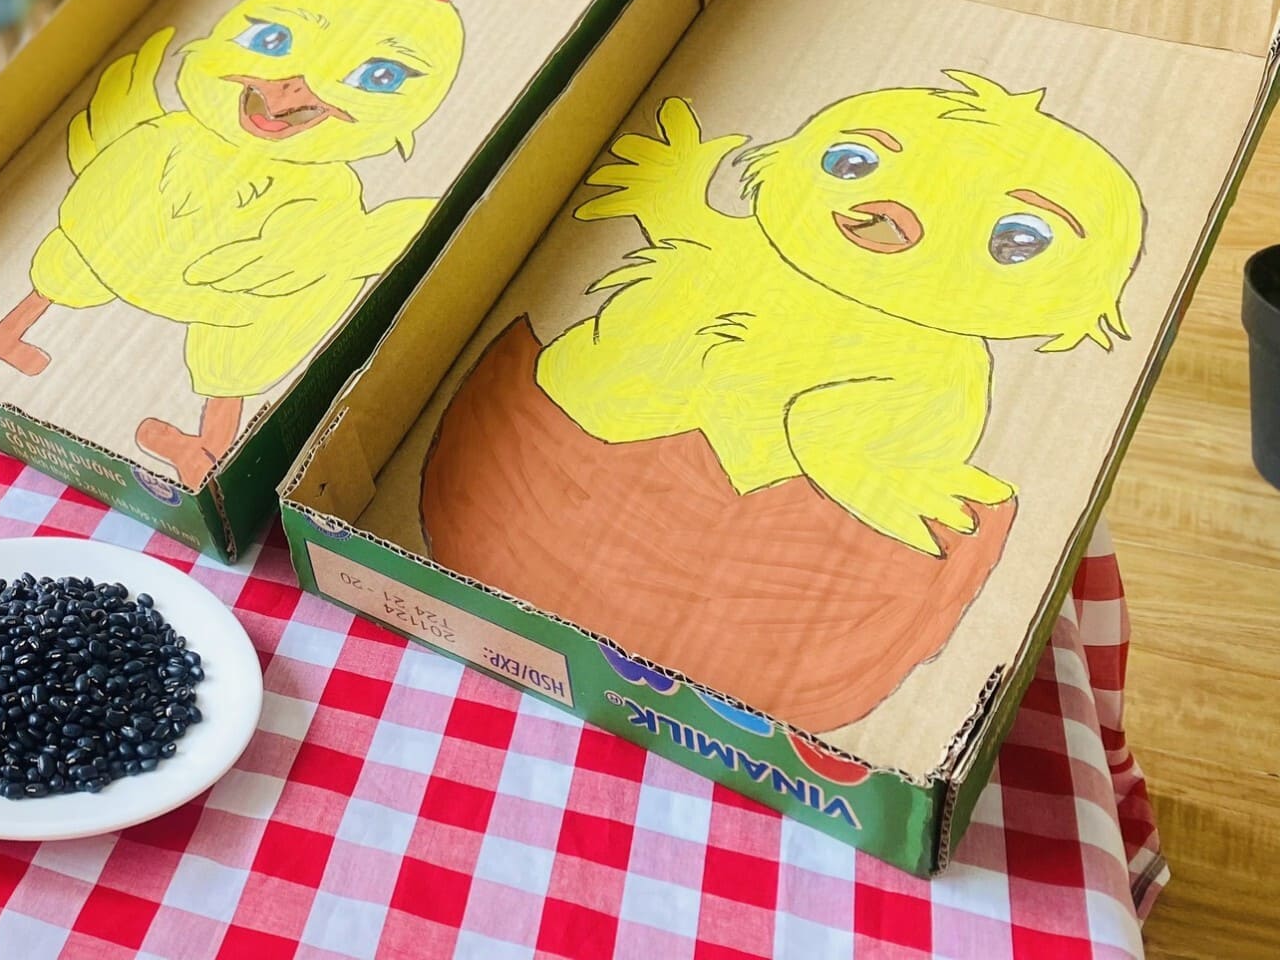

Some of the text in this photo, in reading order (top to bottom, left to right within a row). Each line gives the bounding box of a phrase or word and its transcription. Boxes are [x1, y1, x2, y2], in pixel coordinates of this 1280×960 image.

[340, 572, 363, 591] 20
[383, 590, 405, 604] 21
[384, 602, 455, 643] 201124
[415, 605, 449, 630] T24
